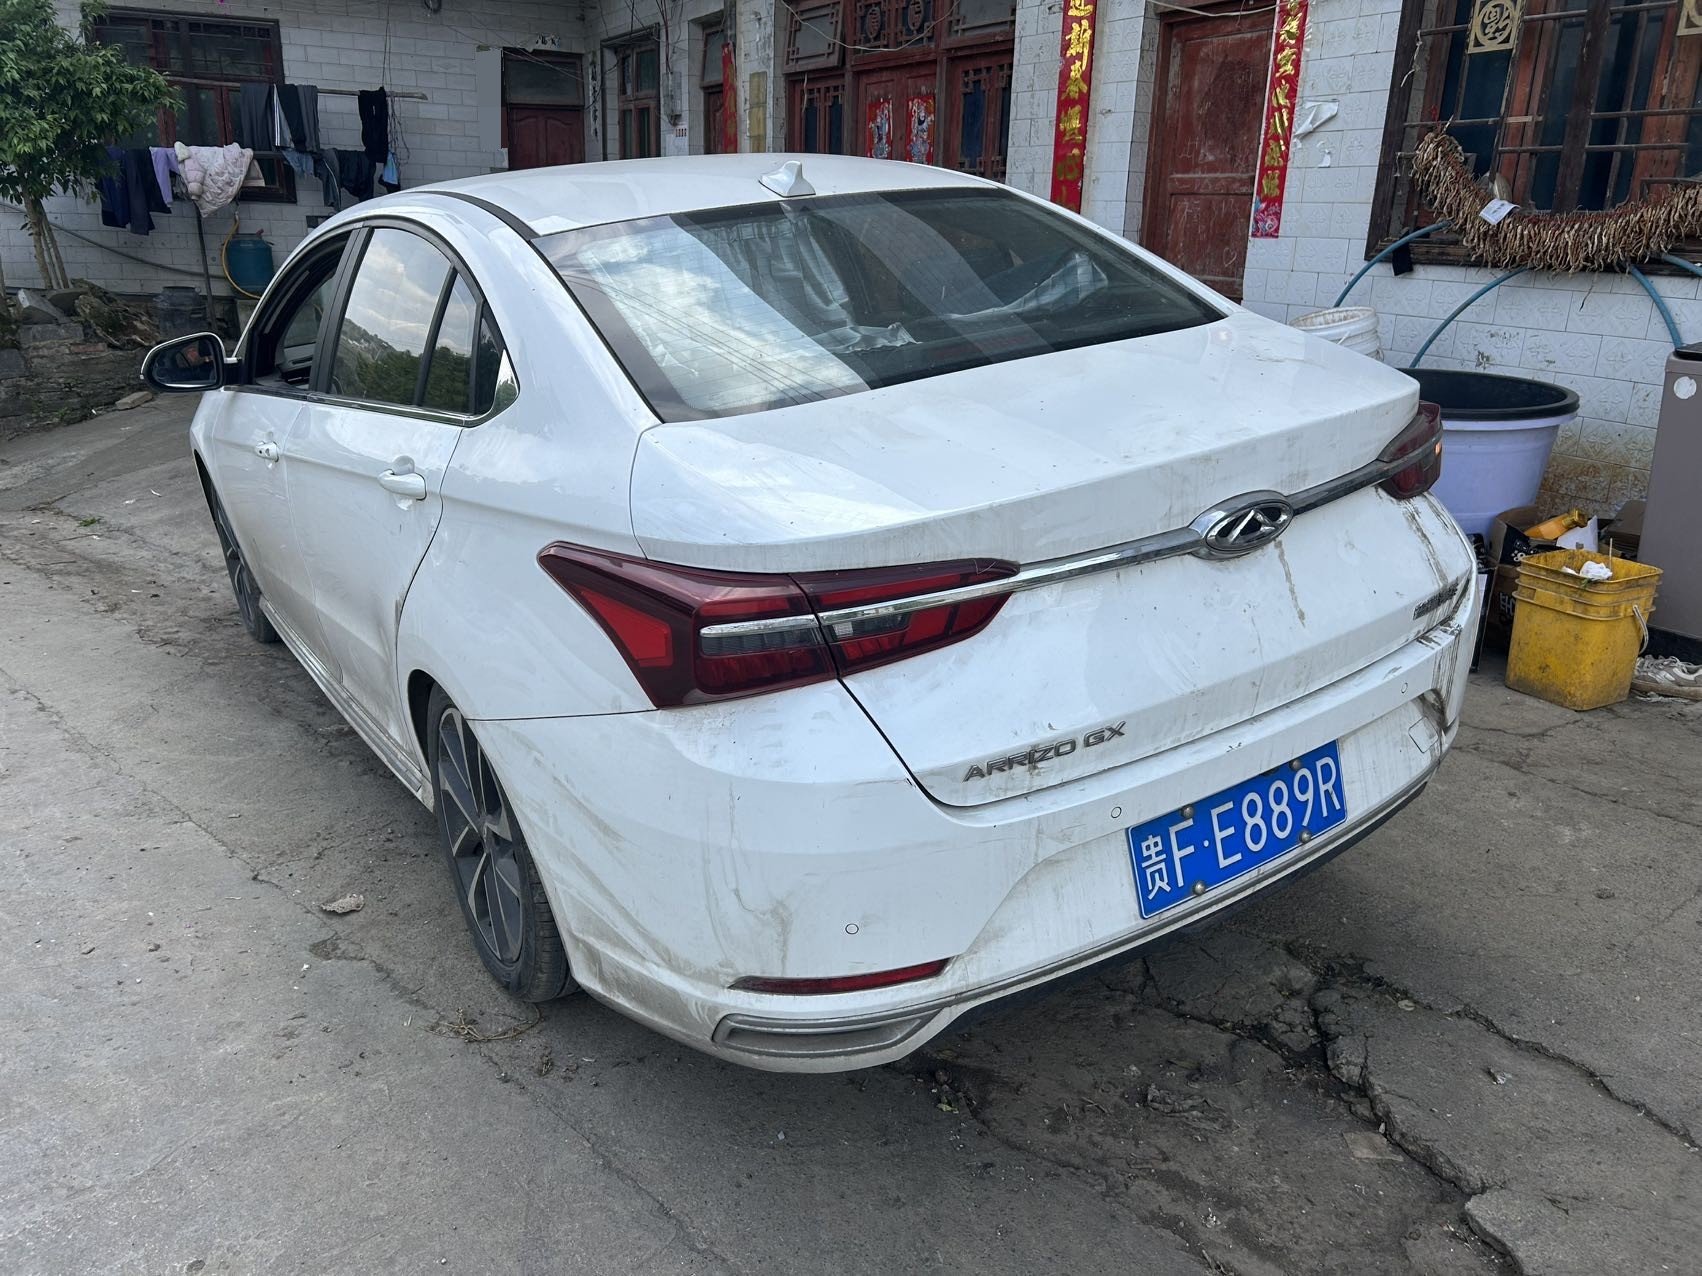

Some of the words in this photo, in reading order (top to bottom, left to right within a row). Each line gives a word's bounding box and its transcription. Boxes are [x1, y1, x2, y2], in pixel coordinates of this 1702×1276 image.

[962, 738, 1077, 782] ARRIZO
[1083, 720, 1126, 748] GX
[1140, 756, 1341, 900] 贵F·E889R
